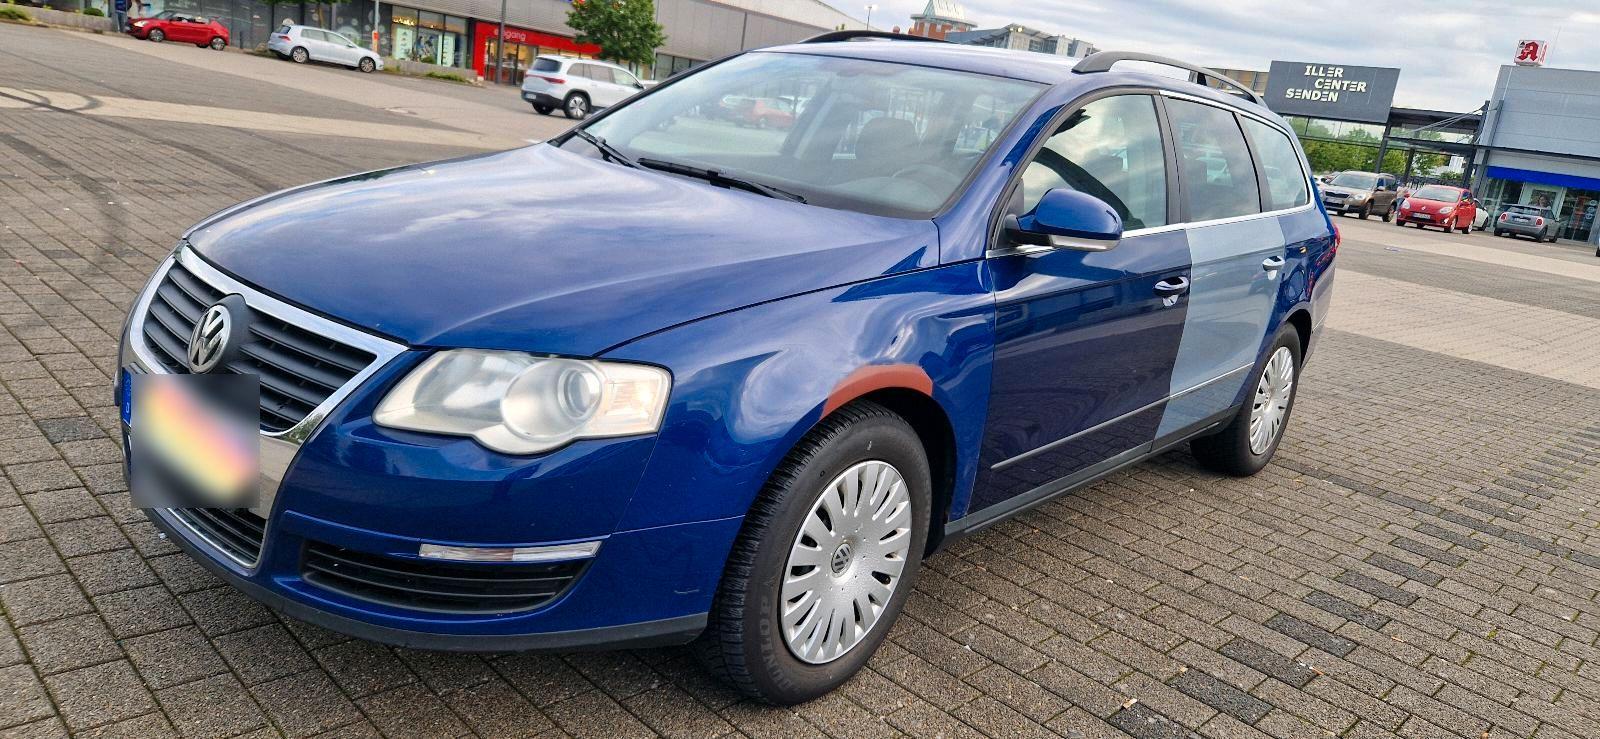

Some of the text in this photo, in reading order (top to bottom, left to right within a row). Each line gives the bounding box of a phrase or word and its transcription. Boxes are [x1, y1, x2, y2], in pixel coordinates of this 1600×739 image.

[1304, 65, 1344, 78] ILLER
[1314, 78, 1367, 93] CENTER
[1285, 88, 1339, 102] SENDEN
